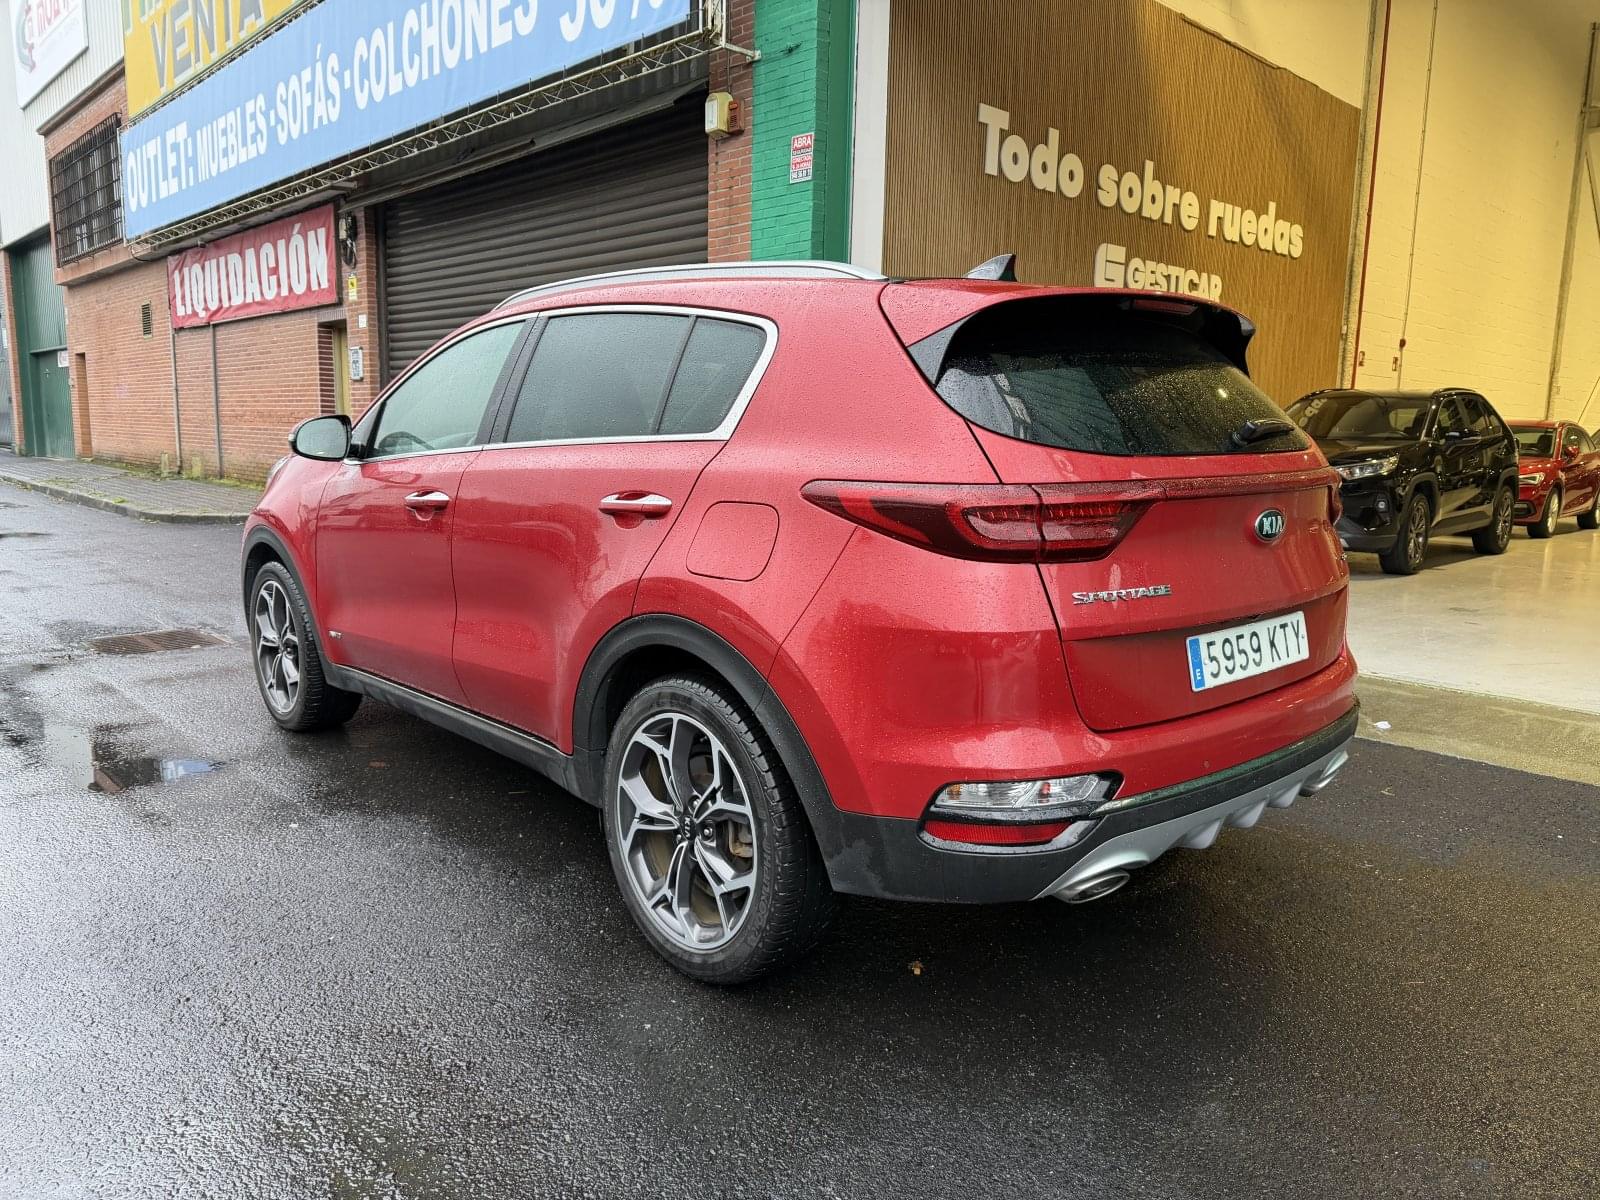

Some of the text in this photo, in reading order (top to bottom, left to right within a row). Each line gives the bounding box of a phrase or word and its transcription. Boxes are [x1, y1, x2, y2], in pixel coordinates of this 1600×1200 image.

[127, 121, 194, 213] OUTLET:
[196, 93, 267, 183] MUEBLES
[793, 135, 812, 149] ABRA
[978, 102, 1304, 259] Todo sobre ruedas
[173, 223, 329, 318] LIQUIDACIÓN
[1126, 257, 1222, 303] GESTICAR
[1262, 515, 1283, 535] KIA
[1071, 584, 1172, 605] SPORTAGE
[1206, 619, 1301, 679] 5959 KTY
